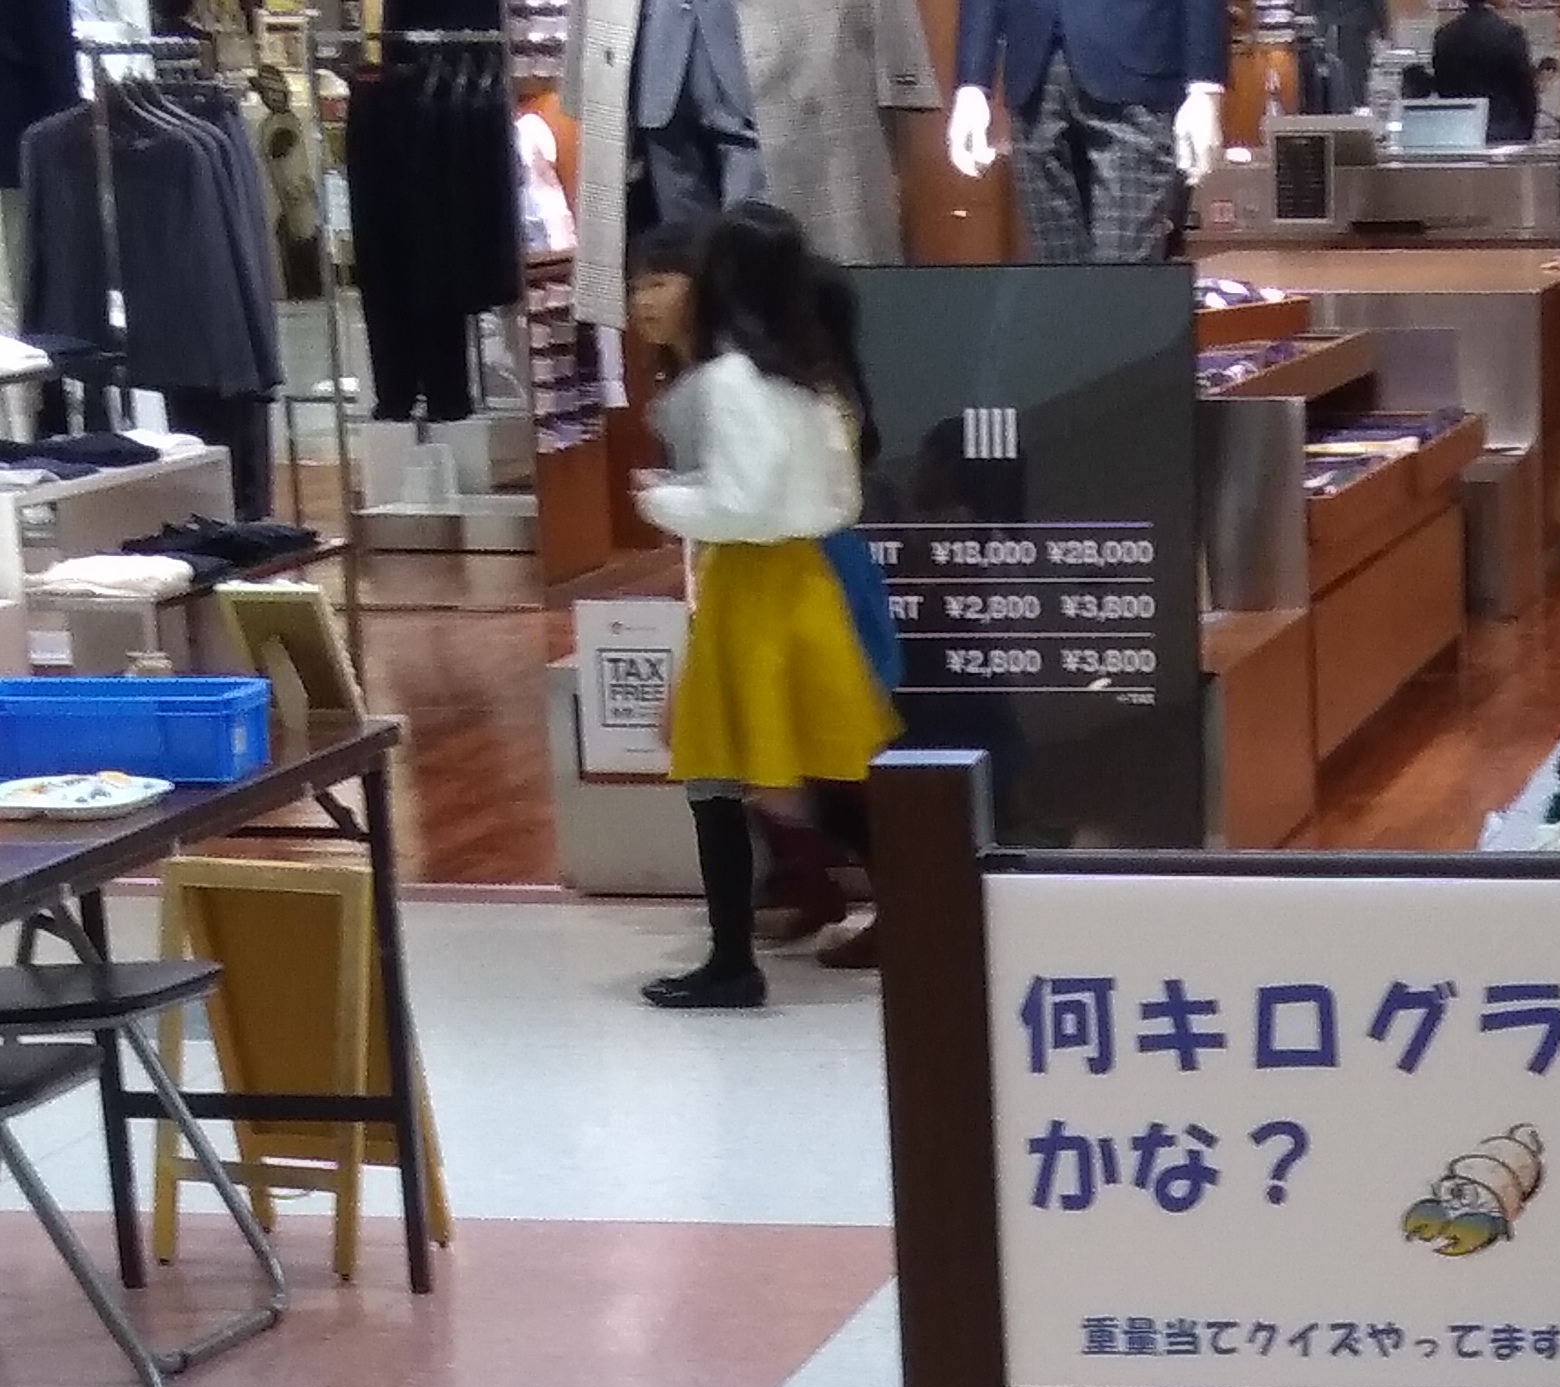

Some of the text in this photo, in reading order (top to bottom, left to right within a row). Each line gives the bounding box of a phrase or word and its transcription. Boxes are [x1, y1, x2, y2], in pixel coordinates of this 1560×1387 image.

[606, 656, 665, 682] TAX
[609, 682, 666, 702] FREE
[1027, 1118, 1311, 1214] かな？
